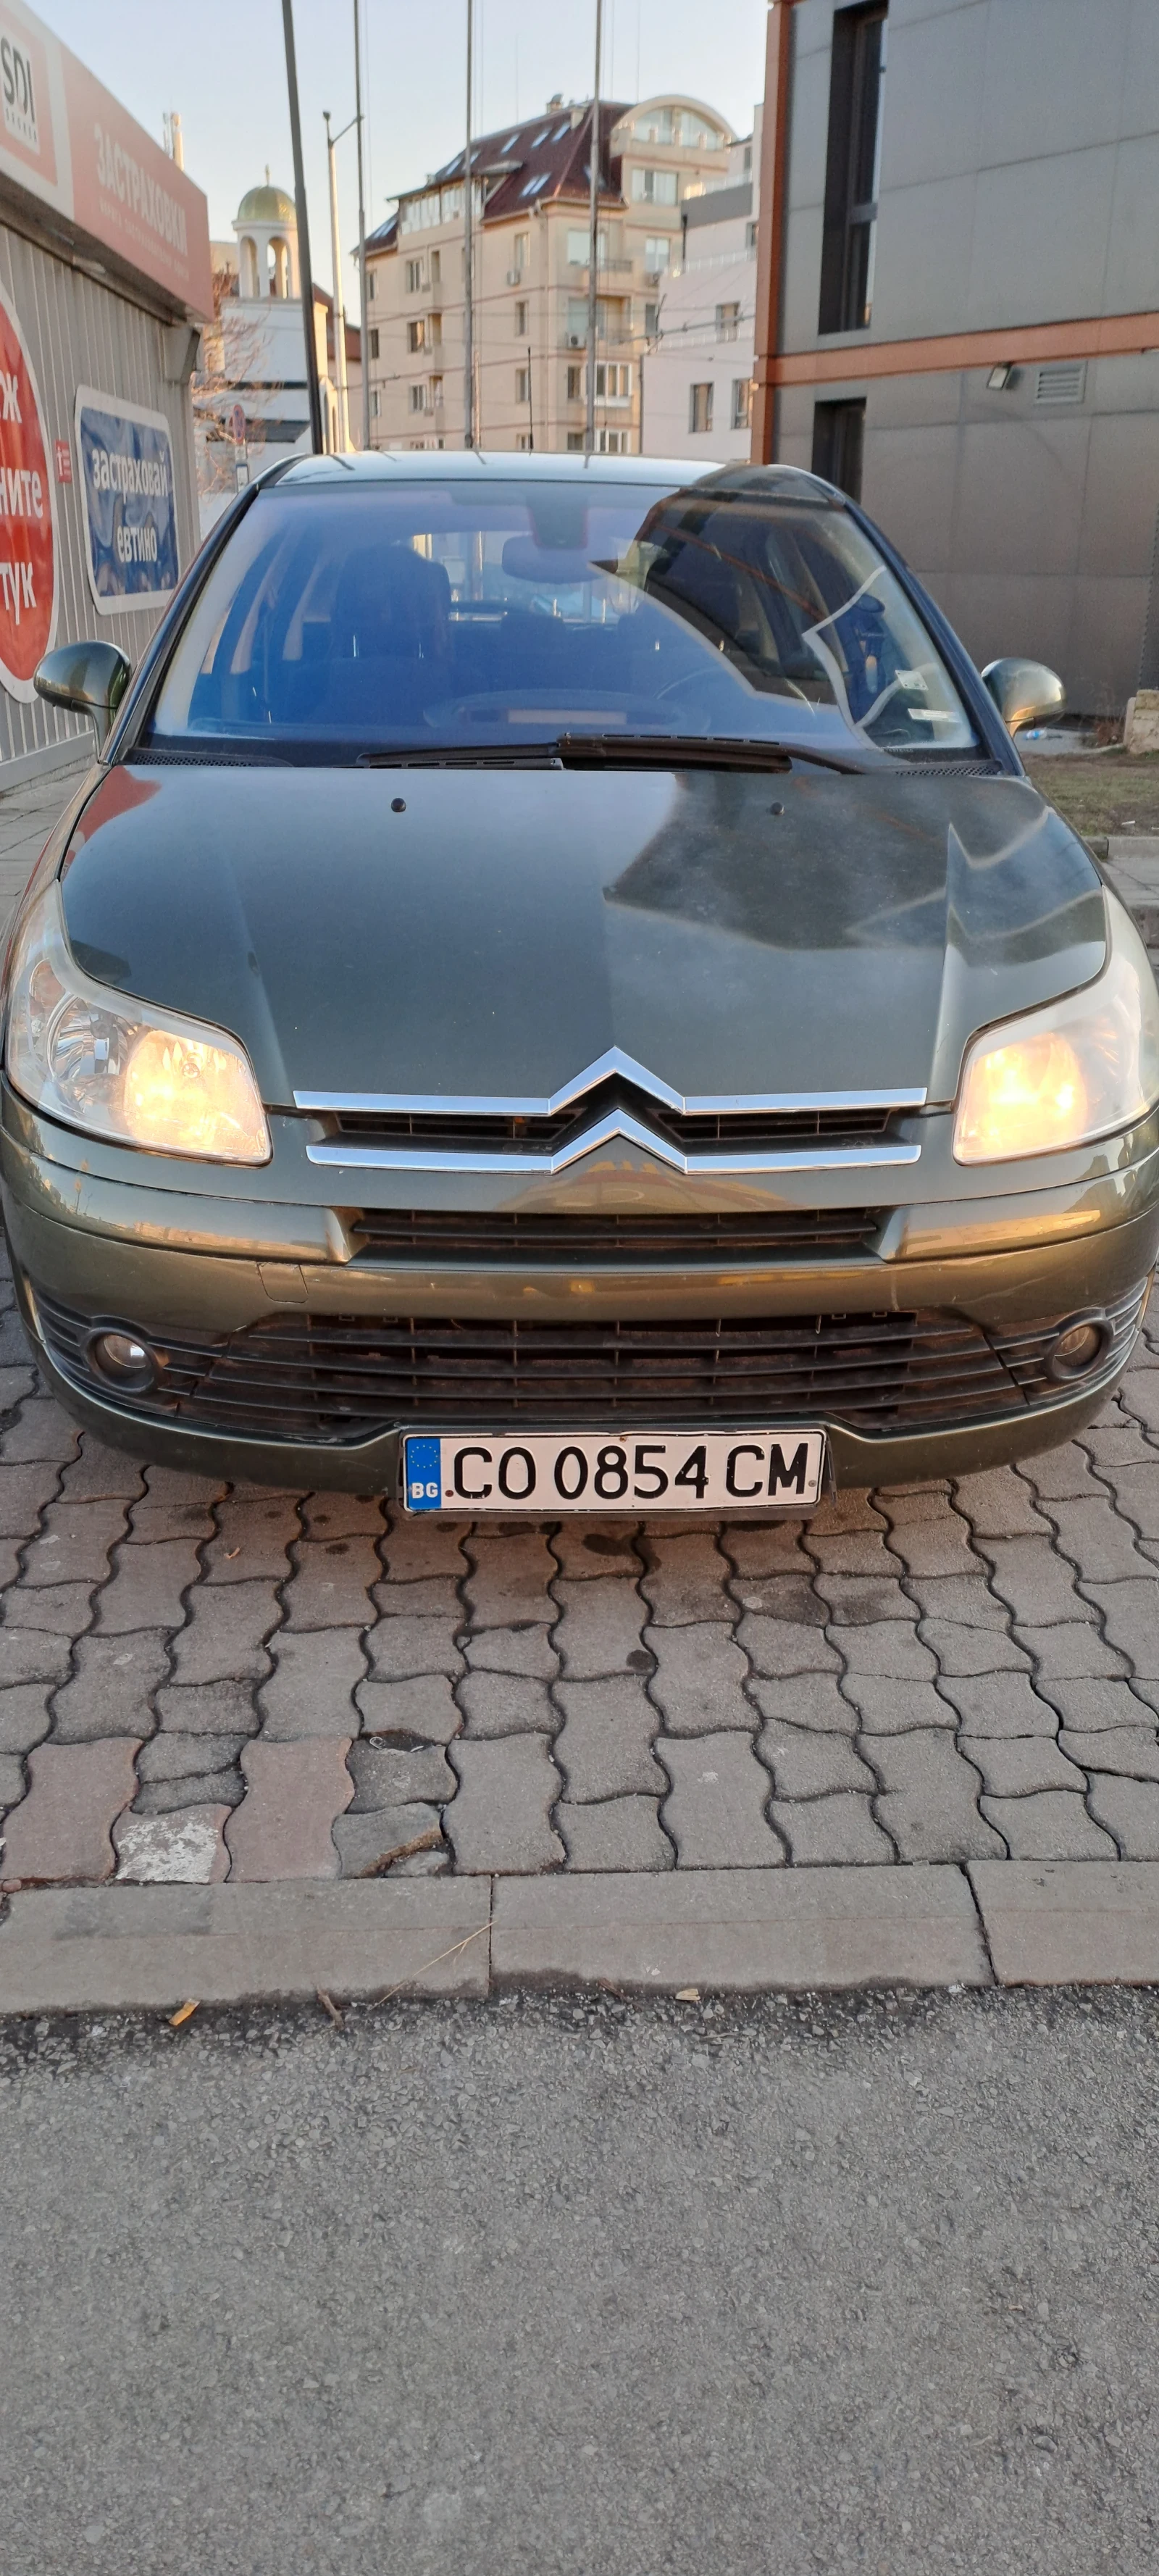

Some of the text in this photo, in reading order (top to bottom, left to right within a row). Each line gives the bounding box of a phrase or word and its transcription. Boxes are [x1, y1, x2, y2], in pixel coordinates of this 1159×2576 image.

[1, 37, 35, 124] SDI
[94, 122, 188, 257] ЗАСТРАХОВКИ
[92, 449, 169, 505] застраховай
[117, 525, 157, 563] евтино
[411, 1483, 438, 1499] BG
[454, 1443, 808, 1500] CO 0854 CM
